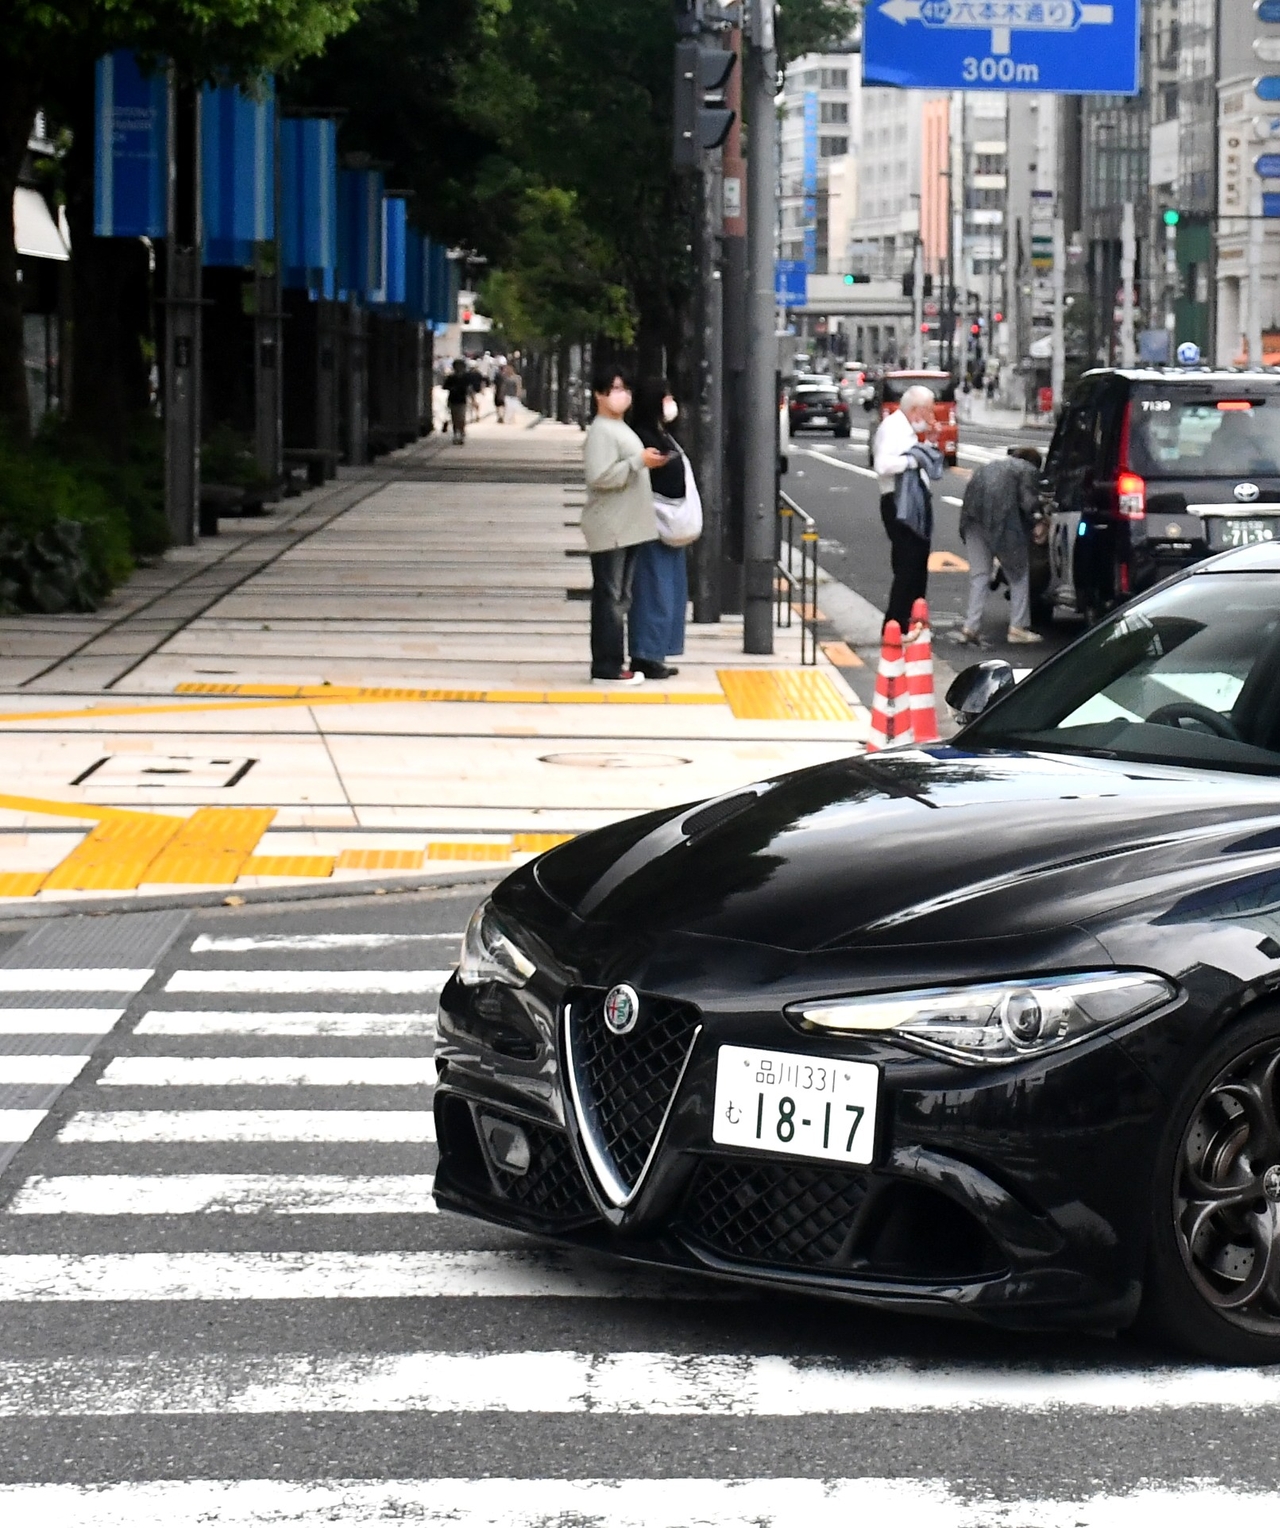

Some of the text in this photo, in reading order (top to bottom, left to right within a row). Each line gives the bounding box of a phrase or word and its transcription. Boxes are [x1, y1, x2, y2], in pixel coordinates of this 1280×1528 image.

[955, 1, 1067, 21] 六本木通り
[962, 56, 1040, 83] 300m
[725, 1092, 865, 1152] む 18-17
